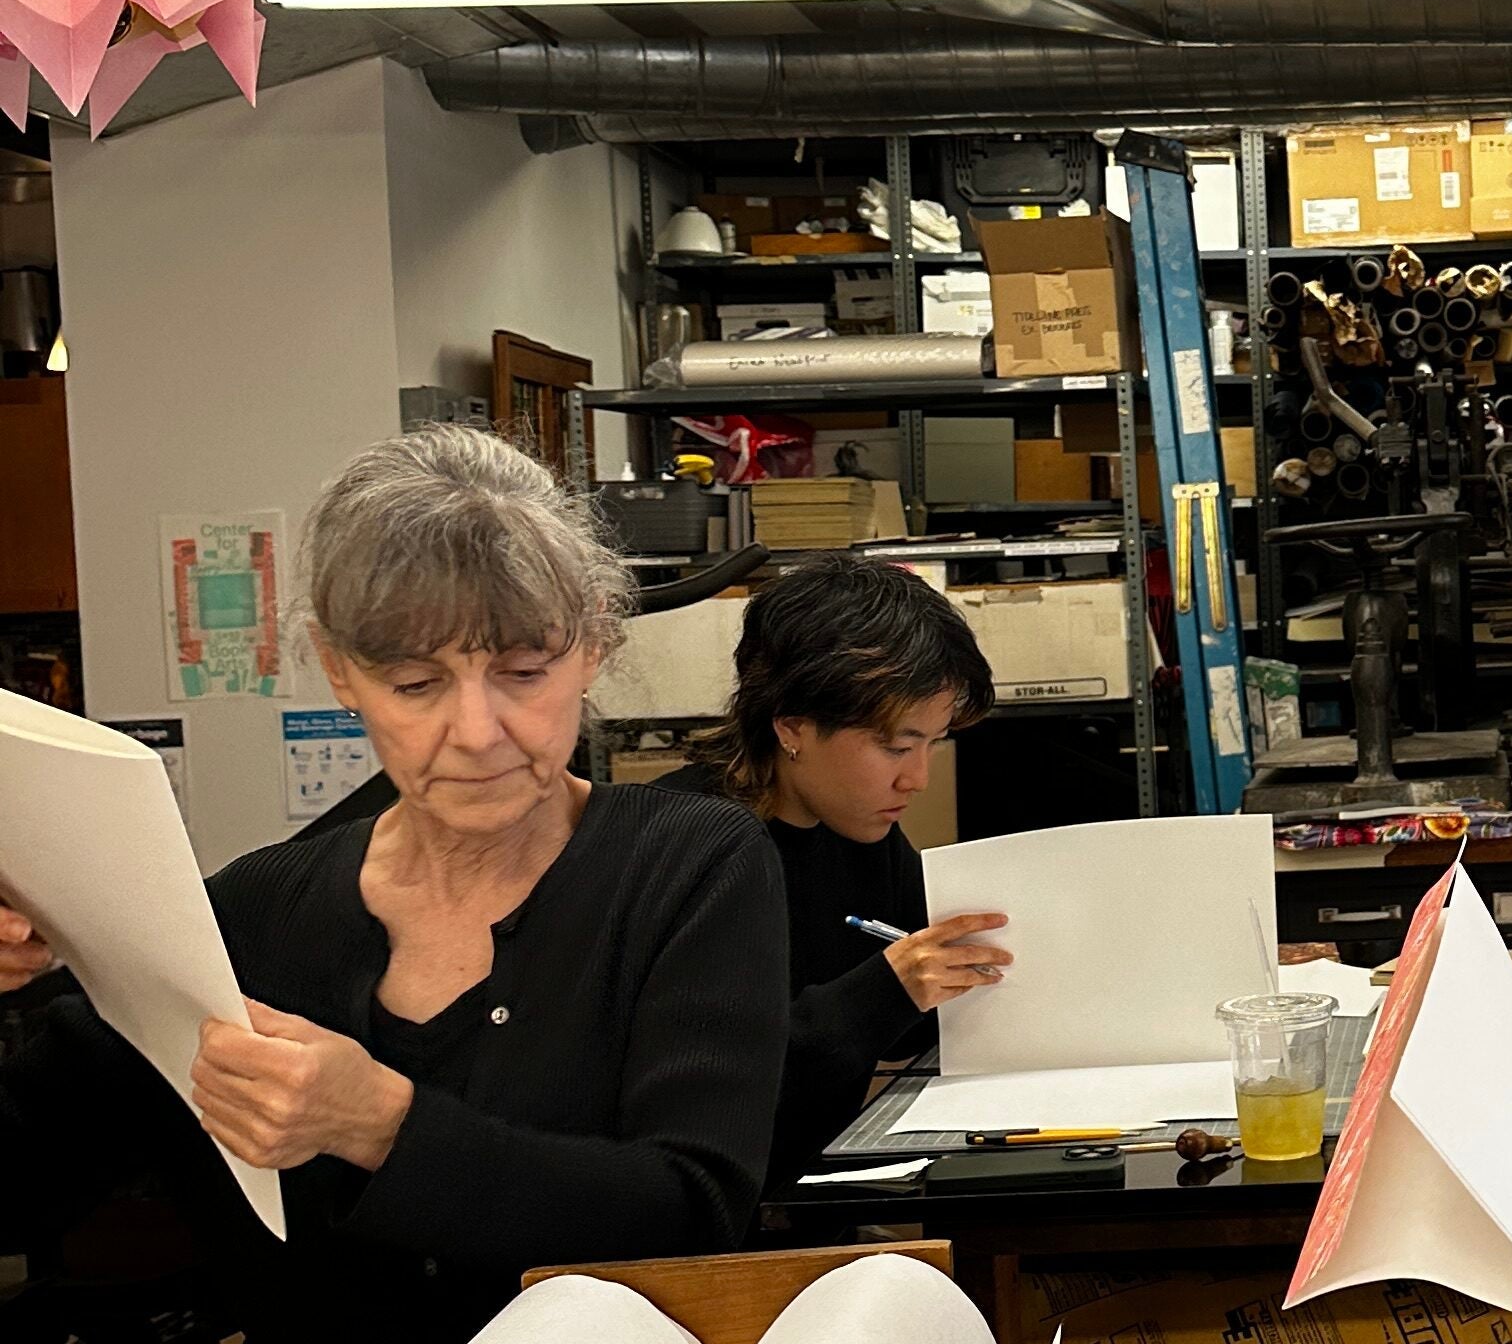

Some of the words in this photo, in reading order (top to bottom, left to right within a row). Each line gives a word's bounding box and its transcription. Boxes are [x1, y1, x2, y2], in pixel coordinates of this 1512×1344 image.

[201, 523, 253, 538] Center
[217, 537, 239, 550] for
[208, 644, 249, 658] Book
[216, 658, 246, 670] Arts
[1015, 686, 1067, 698] STOR-ALL
